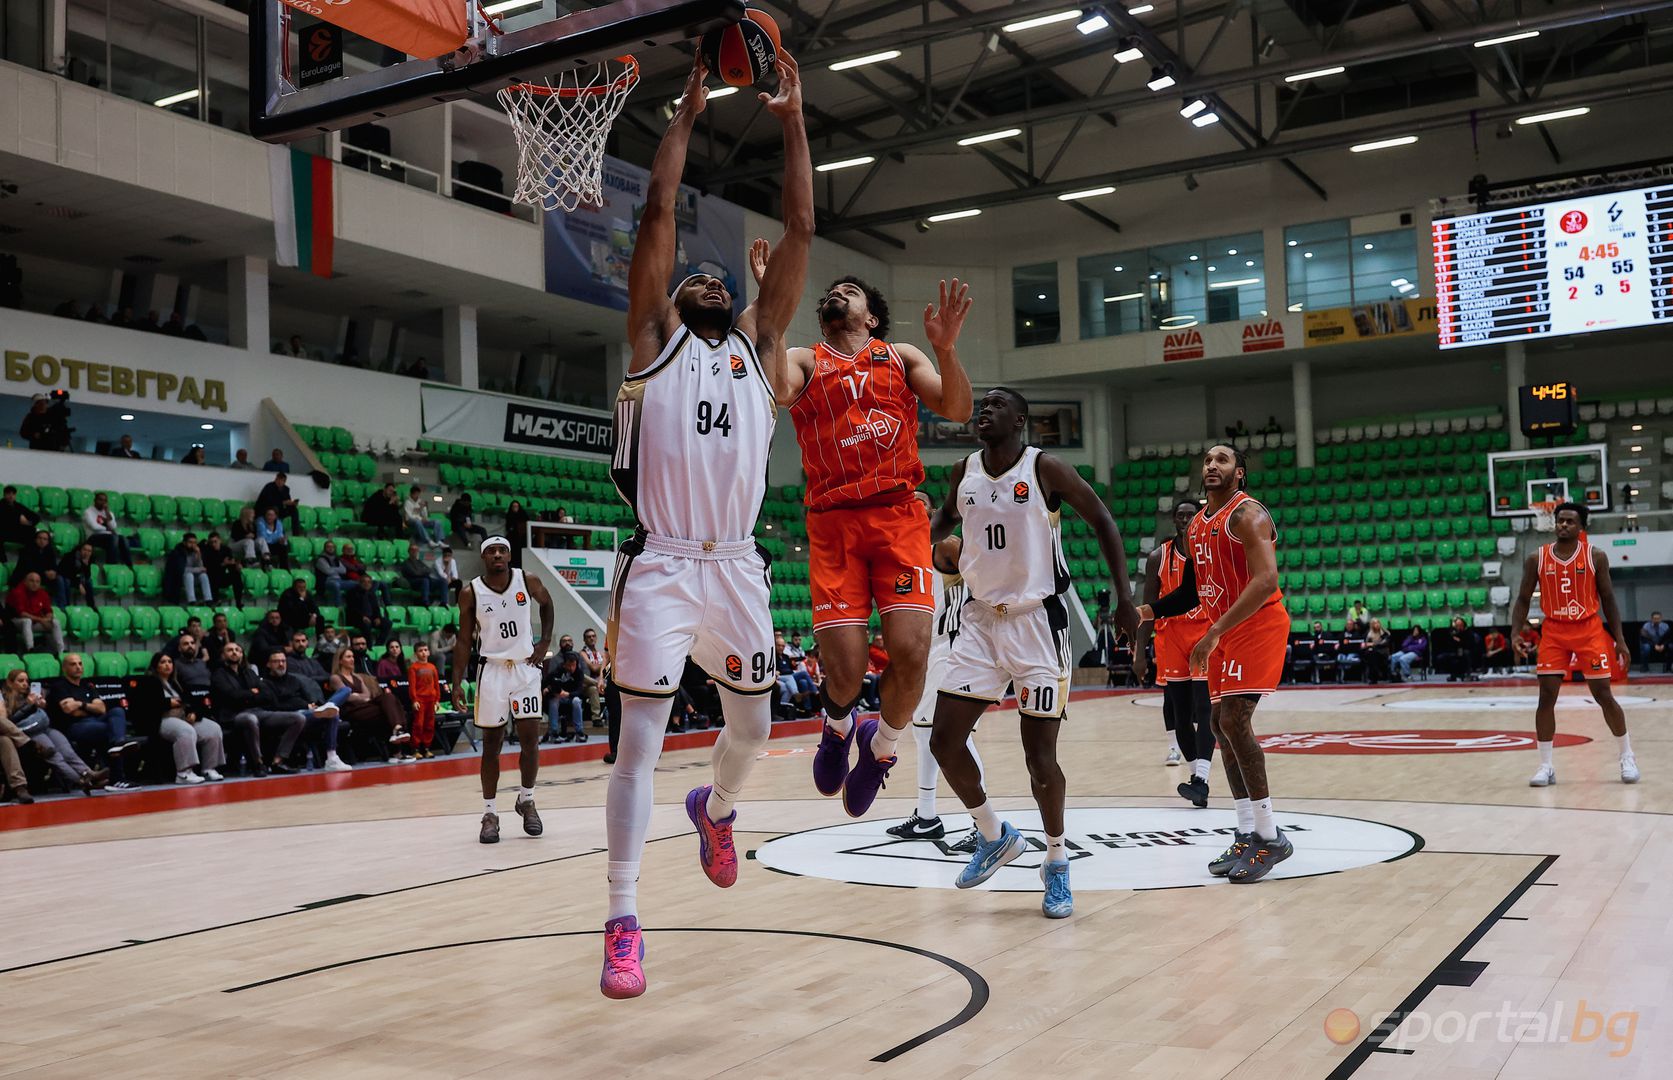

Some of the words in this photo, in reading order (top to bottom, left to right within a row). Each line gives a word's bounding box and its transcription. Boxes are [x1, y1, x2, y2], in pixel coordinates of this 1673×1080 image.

[301, 62, 341, 79] EuroLeague
[1454, 217, 1492, 228] MOTLEY
[1456, 228, 1486, 240] JONES
[1456, 236, 1506, 249] BLAKENEY
[1456, 248, 1495, 260] BRYANT
[1579, 242, 1619, 261] 4:45
[1458, 266, 1504, 280] MALCOLM
[1564, 266, 1584, 281] 54
[1612, 259, 1633, 274] 55
[1458, 278, 1493, 290] ODIASE
[1568, 286, 1578, 300] 2
[1594, 284, 1603, 296] 3
[1620, 279, 1630, 294] 5
[1460, 297, 1512, 311] WAINRIGHT
[1460, 310, 1492, 322] OTURU
[5, 350, 228, 412] БОТЕВГРАД
[843, 370, 869, 400] 17
[697, 400, 731, 437] 94
[856, 424, 870, 433] בית
[985, 524, 1006, 550] 10
[1195, 542, 1213, 565] 24
[1560, 578, 1571, 594] 2
[500, 620, 518, 639] 30
[752, 646, 775, 684] 94
[1600, 654, 1608, 669] 2
[522, 696, 538, 714] 30
[1034, 686, 1054, 712] 10
